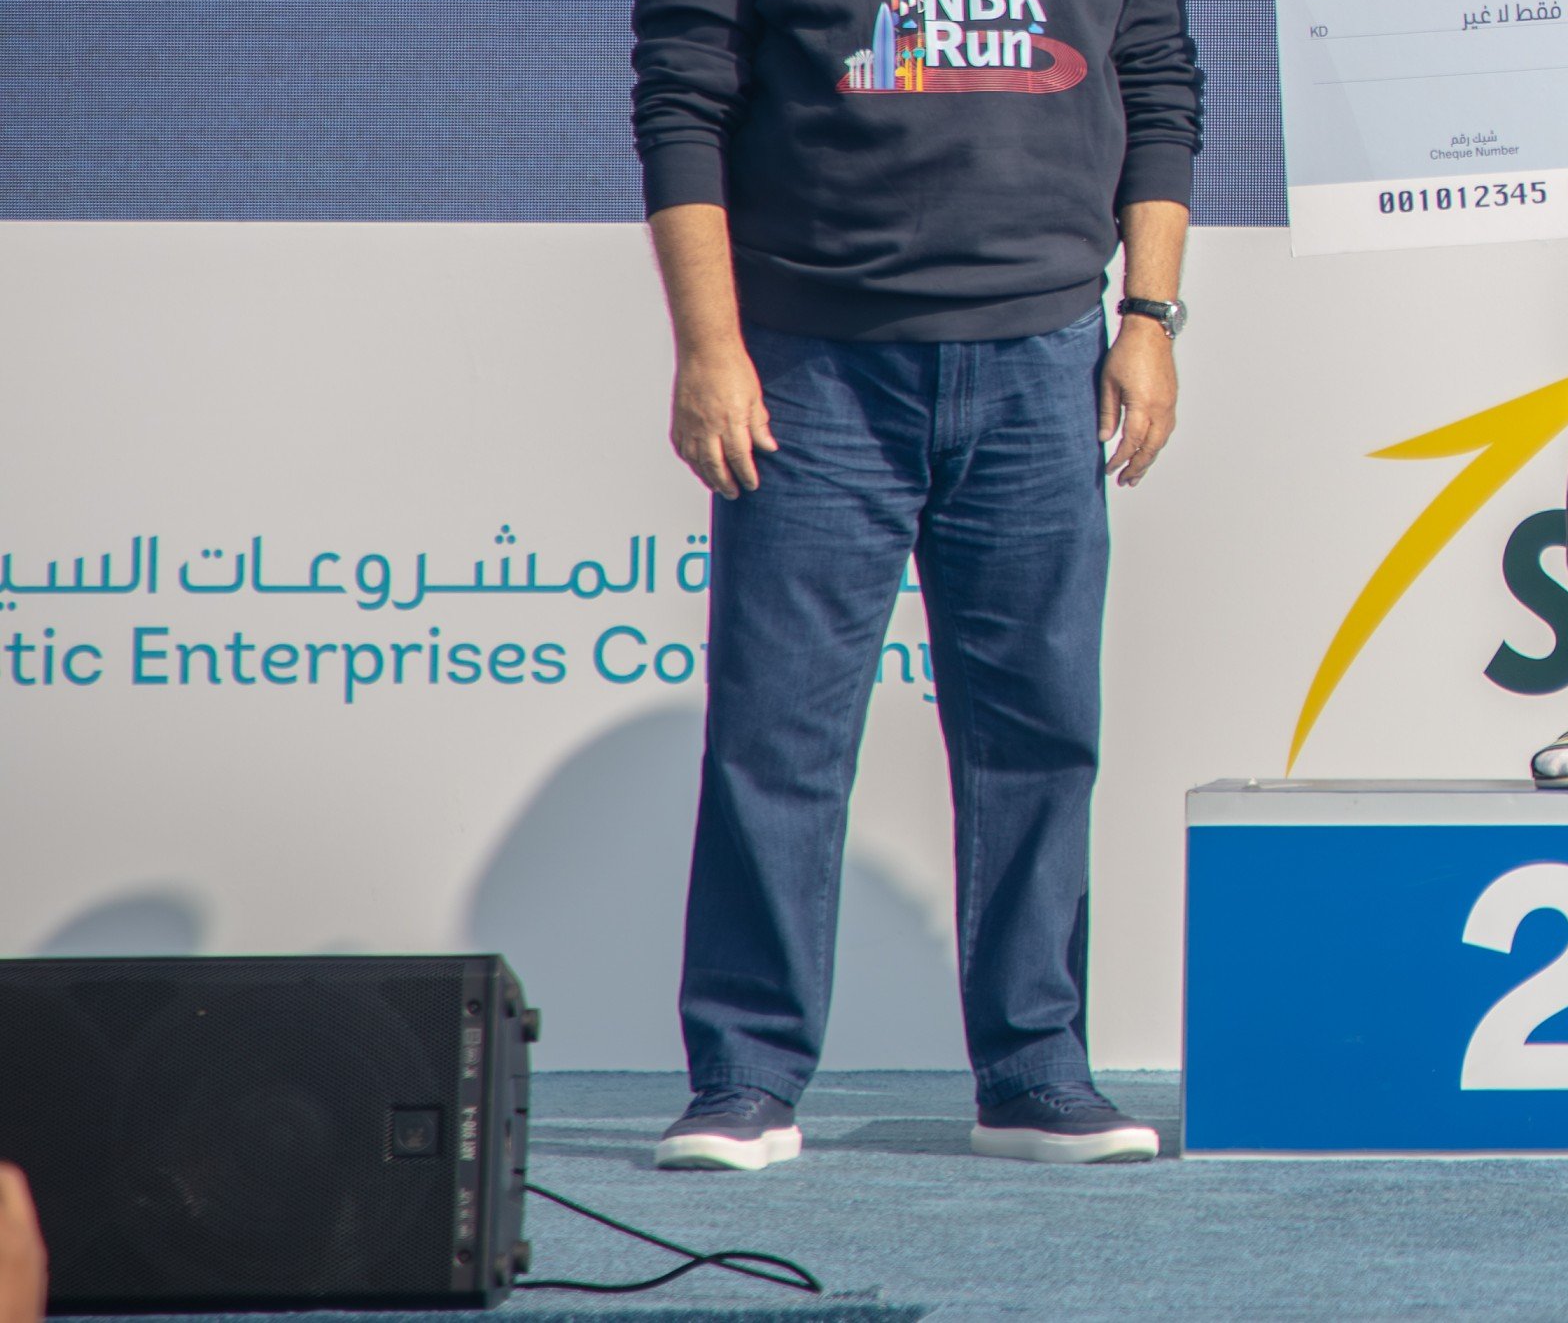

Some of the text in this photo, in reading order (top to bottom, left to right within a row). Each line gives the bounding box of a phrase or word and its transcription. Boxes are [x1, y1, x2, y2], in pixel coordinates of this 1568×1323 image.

[1461, 4, 1491, 31] غير
[1515, 1, 1562, 22] فقط
[924, 20, 1033, 68] Run
[1310, 26, 1328, 38] KD
[1429, 144, 1520, 162] Cheque Number
[1378, 180, 1548, 215] 001012345
[178, 524, 656, 611] المشروعات
[131, 625, 567, 705] Enterprises
